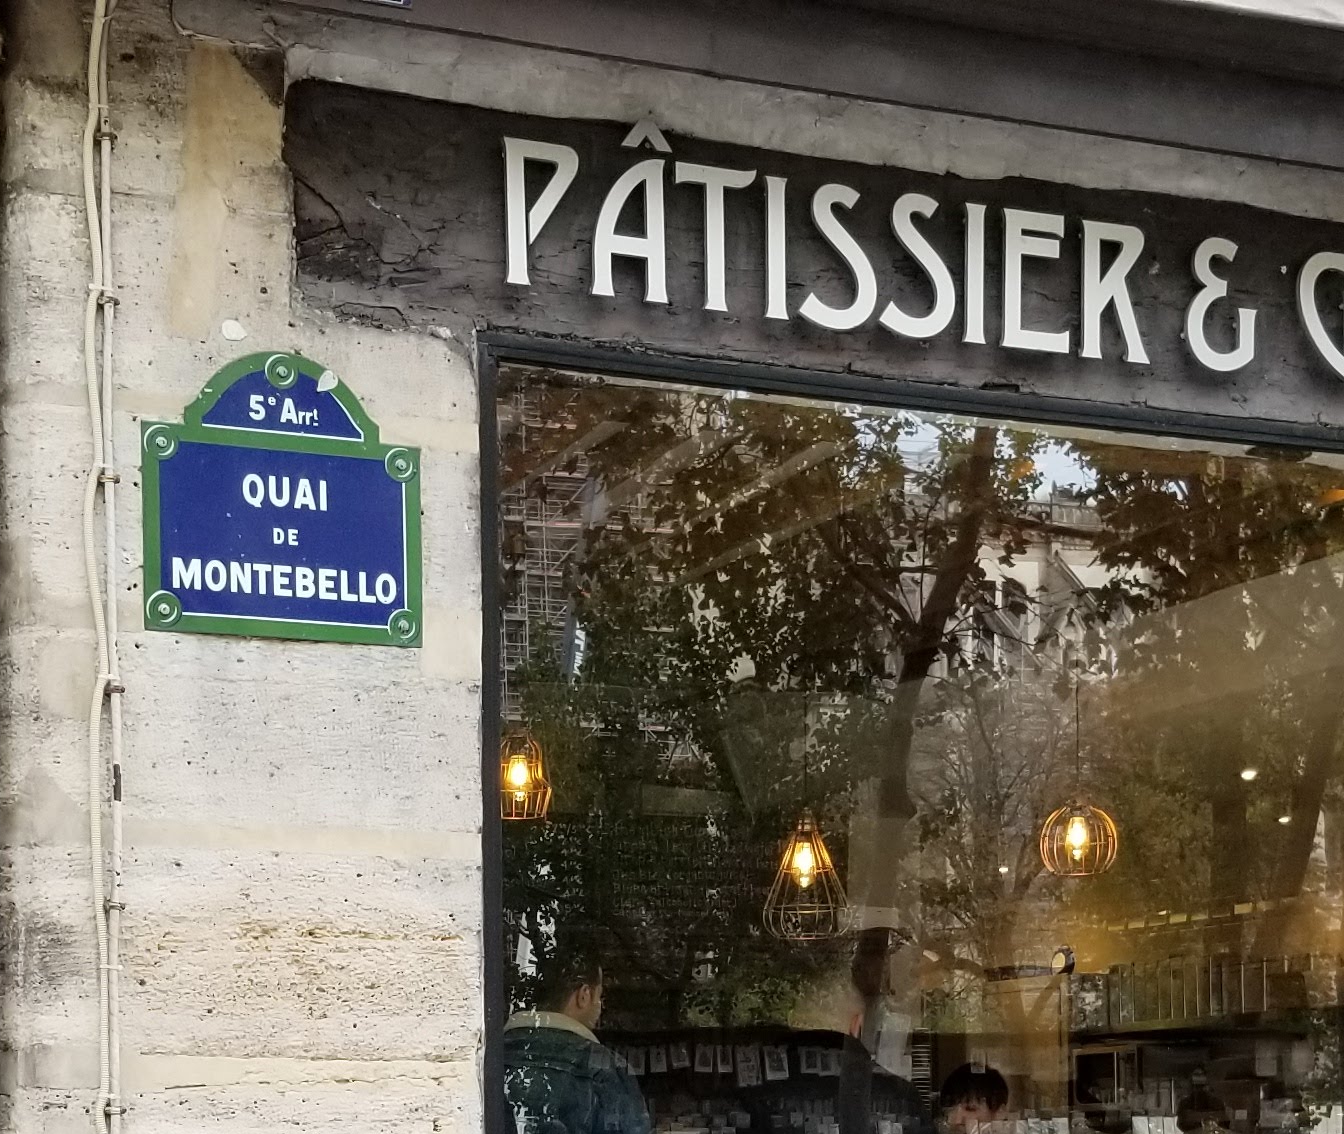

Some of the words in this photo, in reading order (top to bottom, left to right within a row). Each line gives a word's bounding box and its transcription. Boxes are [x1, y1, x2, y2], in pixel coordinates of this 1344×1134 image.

[502, 118, 1151, 366] PÂTISSIER
[1184, 237, 1257, 373] &
[241, 473, 328, 511] QUAI
[273, 528, 298, 545] DE
[171, 557, 396, 604] MONTEBELLO
